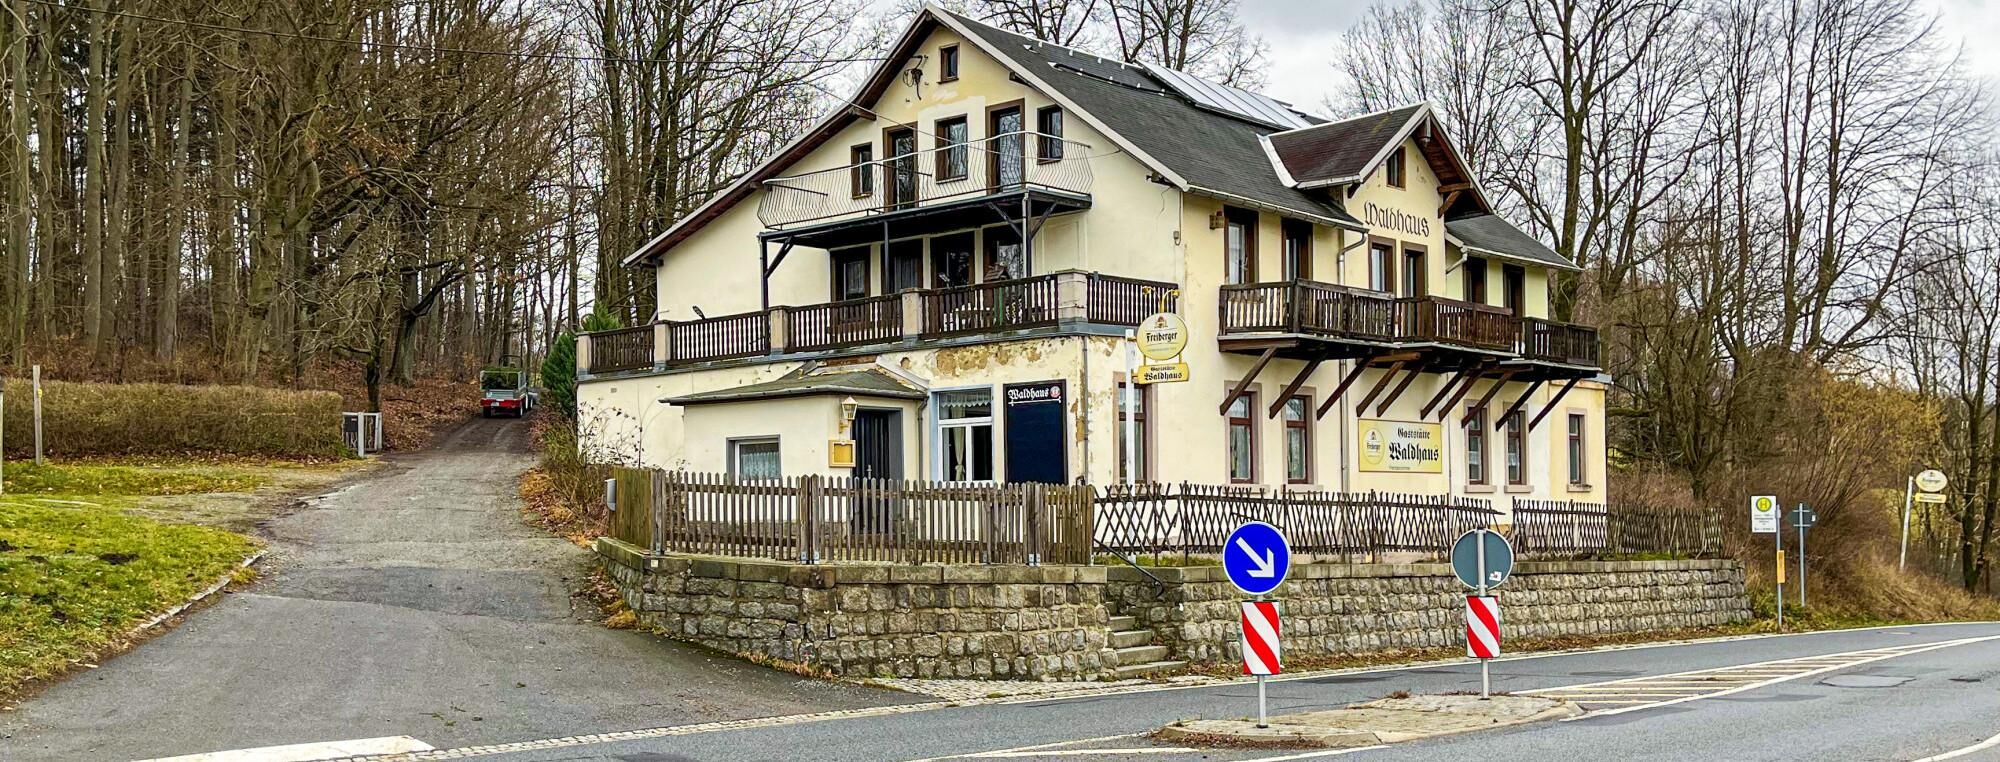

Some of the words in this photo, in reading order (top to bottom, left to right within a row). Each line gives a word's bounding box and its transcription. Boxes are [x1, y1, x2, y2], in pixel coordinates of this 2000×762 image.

[1364, 200, 1430, 238] Waldhaus
[1146, 331, 1178, 343] Freiberger
[1144, 371, 1182, 381] Waldhaus
[1008, 387, 1050, 400] Waldhaus
[1389, 442, 1439, 464] Waldhaus
